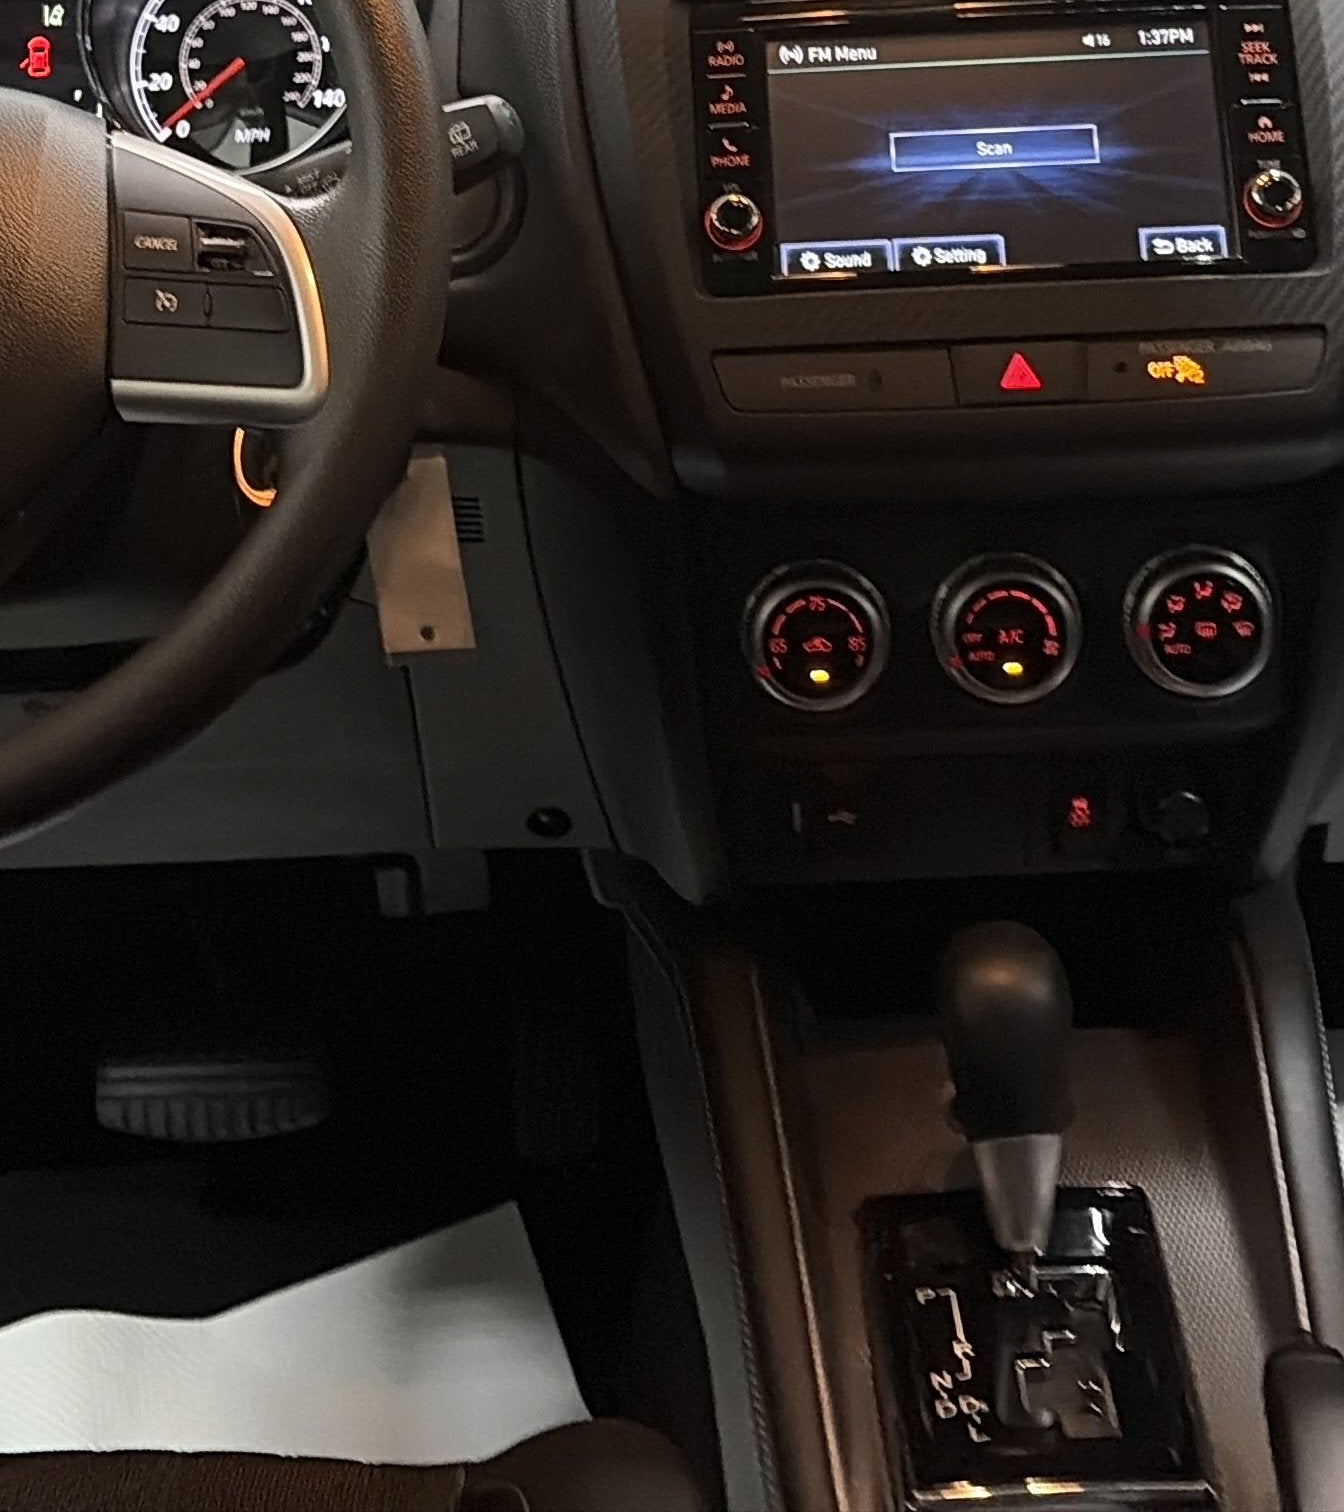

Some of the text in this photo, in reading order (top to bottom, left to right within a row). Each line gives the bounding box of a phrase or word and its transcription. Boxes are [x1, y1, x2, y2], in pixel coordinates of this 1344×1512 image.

[155, 14, 180, 33] 40
[1137, 27, 1195, 46] 1:37PM
[807, 45, 878, 63] FM Menu
[1240, 41, 1271, 53] SEEK
[707, 54, 745, 67] RADIO
[1237, 51, 1279, 65] TRACK
[148, 72, 173, 92] 20
[313, 88, 346, 108] 140
[708, 102, 748, 115] MEDIA
[176, 119, 190, 138] 0
[1247, 130, 1286, 144] HOME
[976, 141, 1013, 157] Scan
[710, 154, 751, 168] PHONE
[1174, 236, 1215, 254] Back
[823, 251, 872, 269] Sound
[932, 246, 988, 265] Setting
